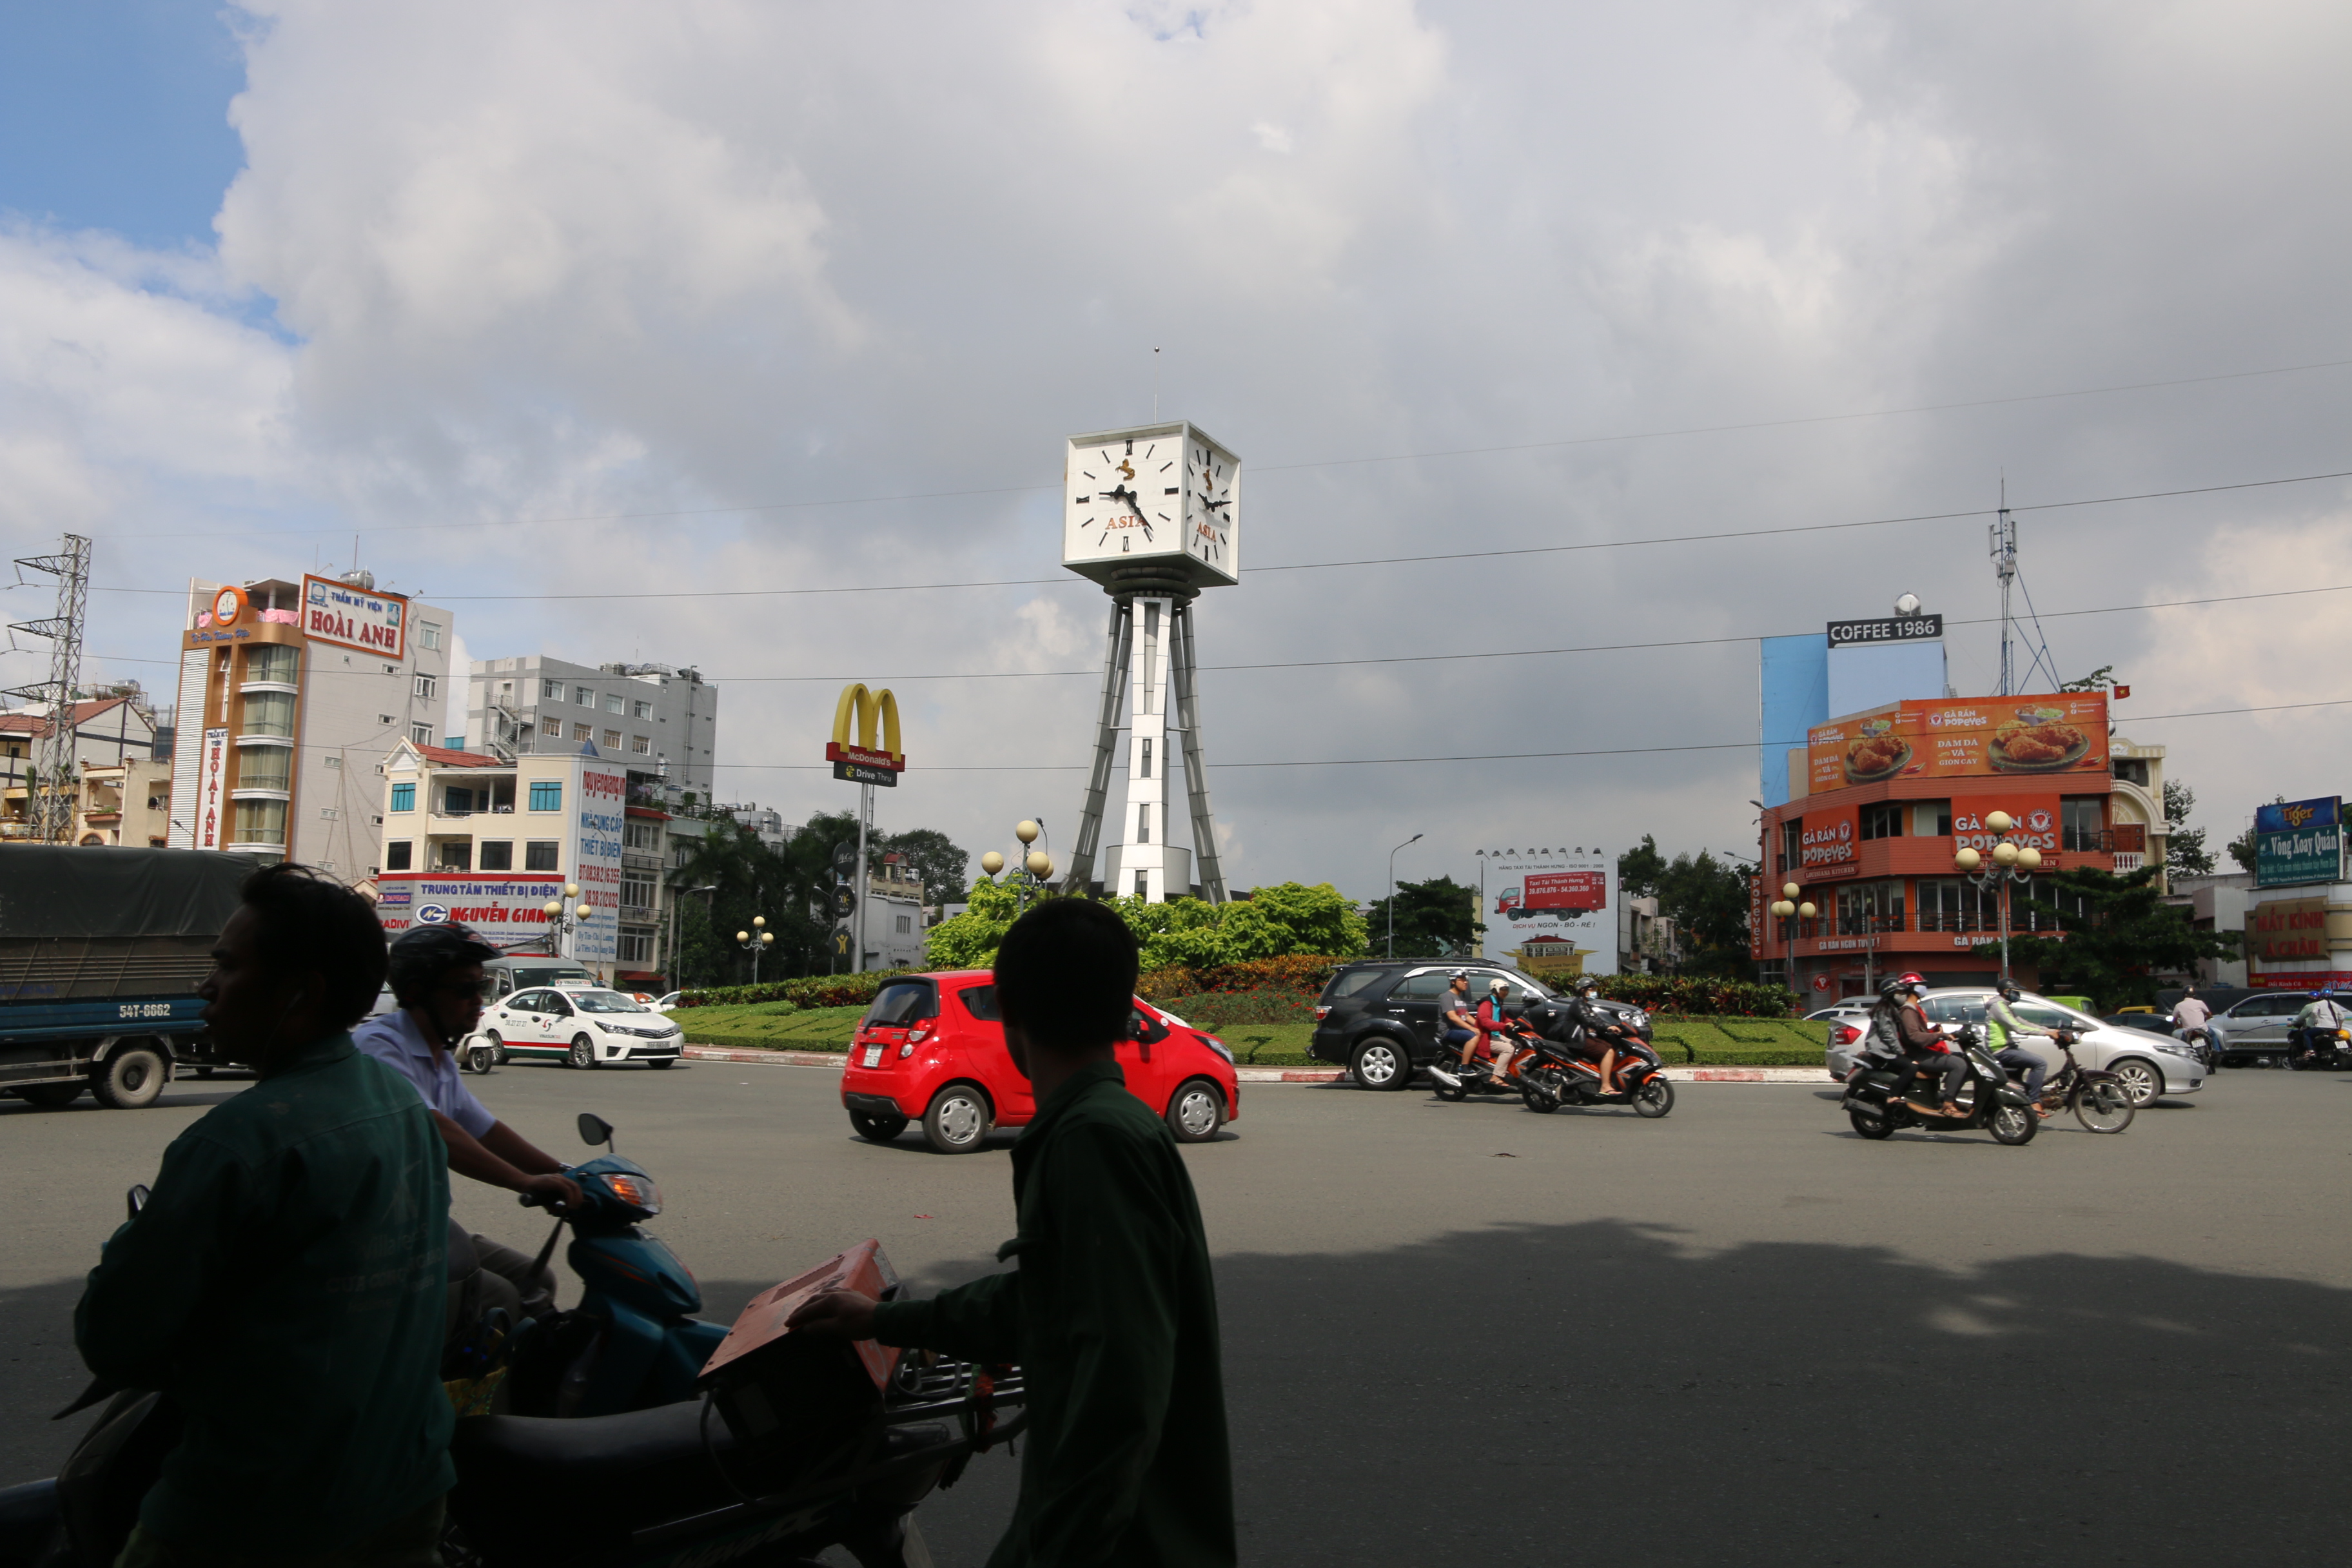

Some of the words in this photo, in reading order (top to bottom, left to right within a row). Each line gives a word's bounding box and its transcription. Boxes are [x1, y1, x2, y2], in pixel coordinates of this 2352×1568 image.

[1105, 516, 1148, 529] ASIA
[1197, 522, 1217, 542] ASIA
[331, 591, 351, 604] THẨM
[354, 597, 364, 608] MỸ
[367, 601, 382, 614] VIỆN
[310, 610, 353, 638] HOÀI
[359, 622, 397, 648] ANH
[1830, 623, 1890, 641] COFFEE
[1895, 620, 1935, 637] 1986
[1944, 710, 1957, 718] GÀ
[1957, 709, 1975, 718] RÁN
[848, 752, 891, 766] McDonald's
[582, 768, 625, 801] nguyengiang.vn
[856, 769, 876, 779] Drive
[877, 772, 892, 782] Thru
[581, 809, 594, 829] NHÀ
[594, 814, 610, 832] CUNG
[610, 810, 623, 833] CẤP
[1955, 813, 1981, 831] GÀ
[2282, 805, 2315, 827] Tiger
[581, 832, 599, 855] THIẾT
[1803, 828, 1816, 845] GÀ
[1818, 826, 1836, 843] RÁN
[2271, 836, 2292, 859] Vòng
[2293, 834, 2313, 856] Xoay
[2315, 830, 2337, 856] Quán
[1832, 867, 1854, 875] KITCHEN
[421, 884, 458, 895] TRUNG
[459, 883, 482, 896] TÂM
[484, 881, 516, 896] THIẾT
[517, 886, 528, 898] BỊ
[531, 884, 558, 899] ĐIỆN
[449, 901, 509, 923] NGUYỄN
[2289, 906, 2324, 930] KÍNH
[1819, 940, 1827, 950] GÀ
[1828, 939, 1839, 950] RÁN
[1841, 939, 1856, 949] NGON
[1857, 938, 1875, 948] TUYT
[1954, 935, 1968, 946] GÀ
[119, 1004, 170, 1018] 54T-6662
